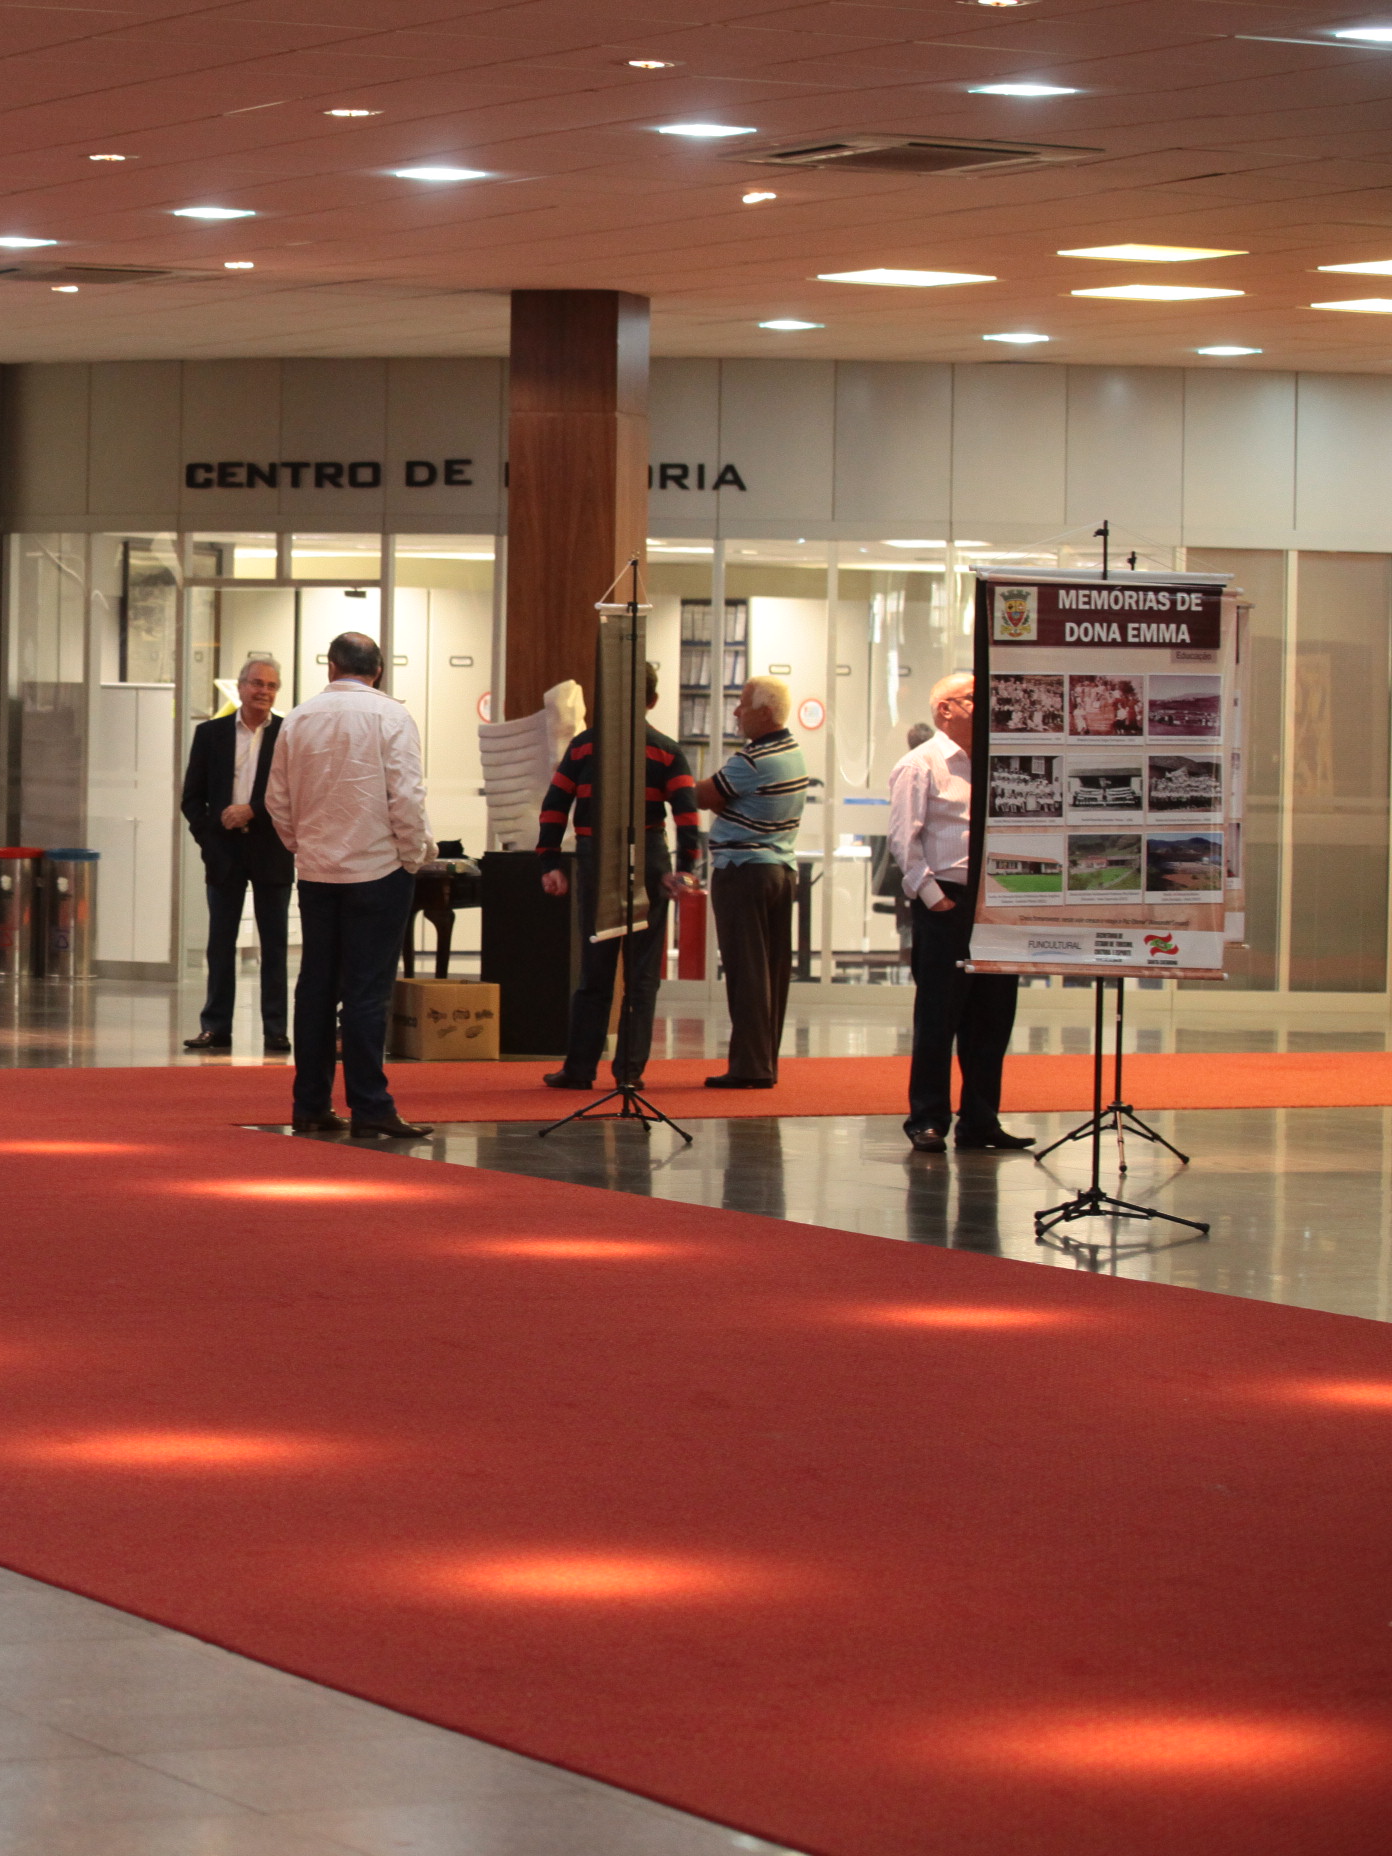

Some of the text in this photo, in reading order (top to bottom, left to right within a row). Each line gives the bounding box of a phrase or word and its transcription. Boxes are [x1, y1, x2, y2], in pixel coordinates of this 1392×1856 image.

[185, 460, 382, 489] CENTRO
[405, 459, 473, 487] DE
[1058, 586, 1203, 611] MEMÓRIAS DE
[1065, 622, 1191, 643] DONA EMMA
[1028, 940, 1082, 950] FUNCULTURAL
